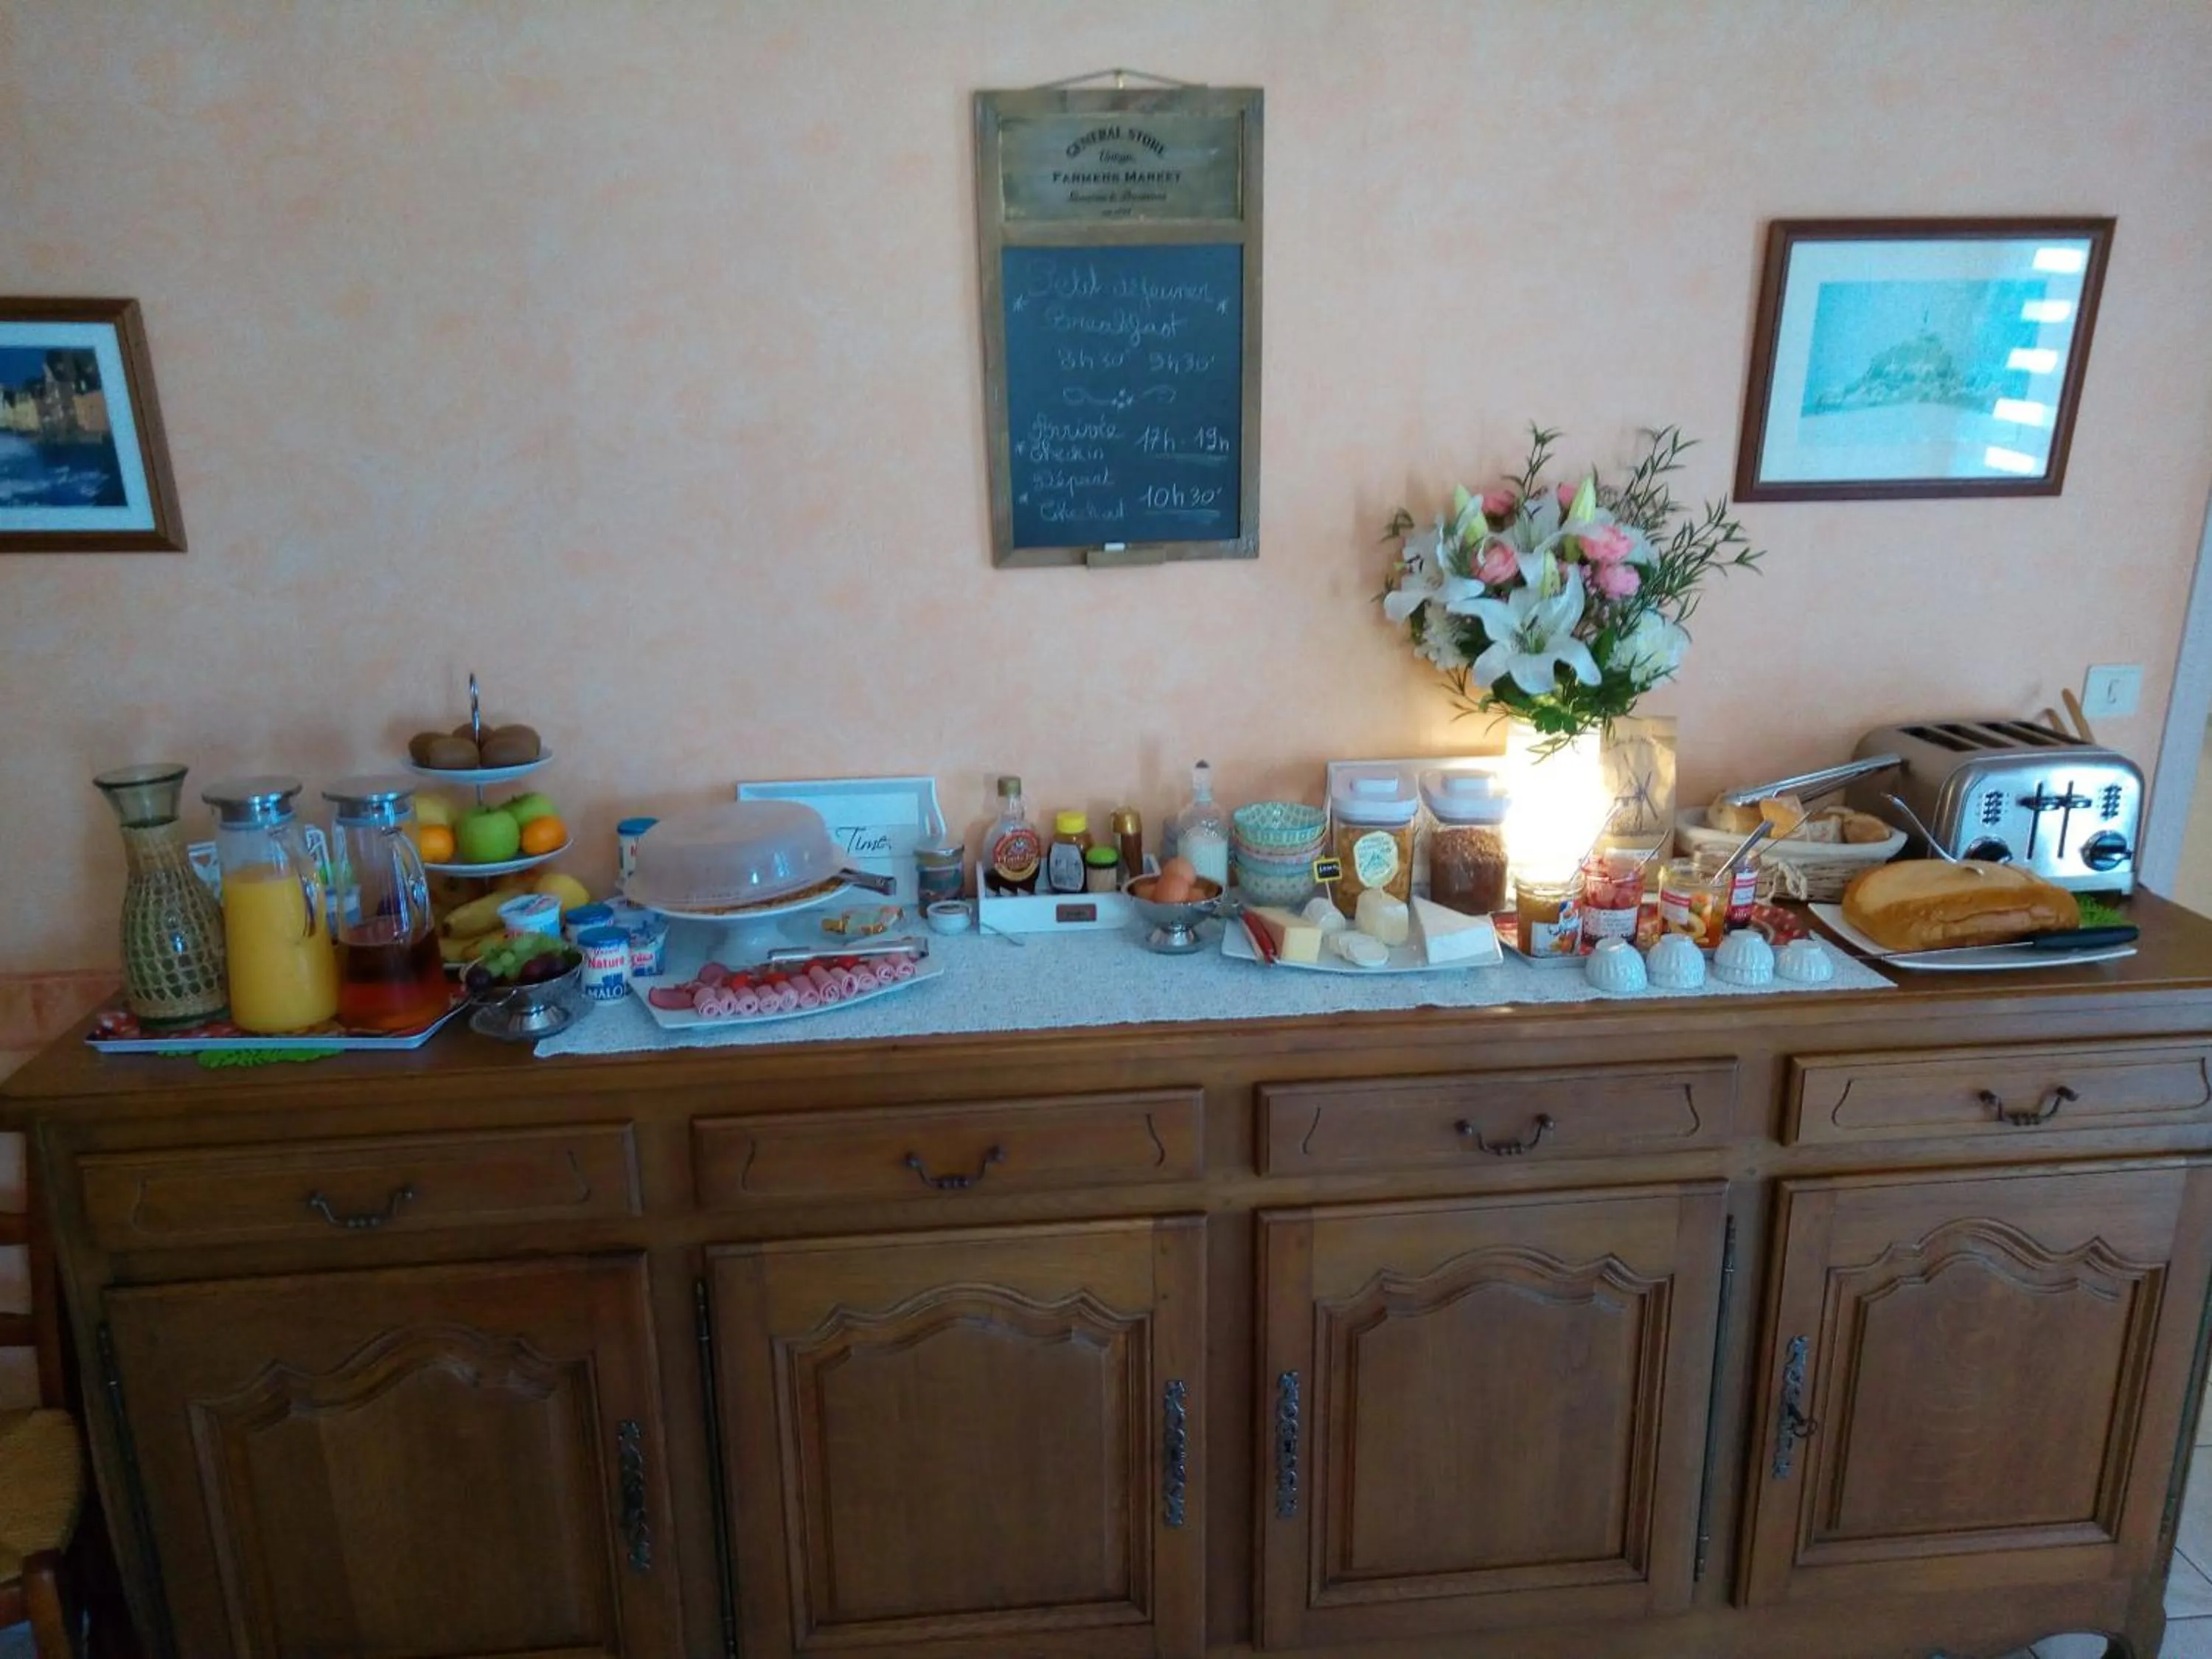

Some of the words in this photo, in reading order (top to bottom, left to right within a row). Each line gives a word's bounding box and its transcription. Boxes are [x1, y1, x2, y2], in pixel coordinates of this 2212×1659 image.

[1065, 125, 1121, 159] GENERAL
[1128, 128, 1166, 159] STORE
[1124, 170, 1182, 184] MARKET
[588, 984, 624, 999] MALO
